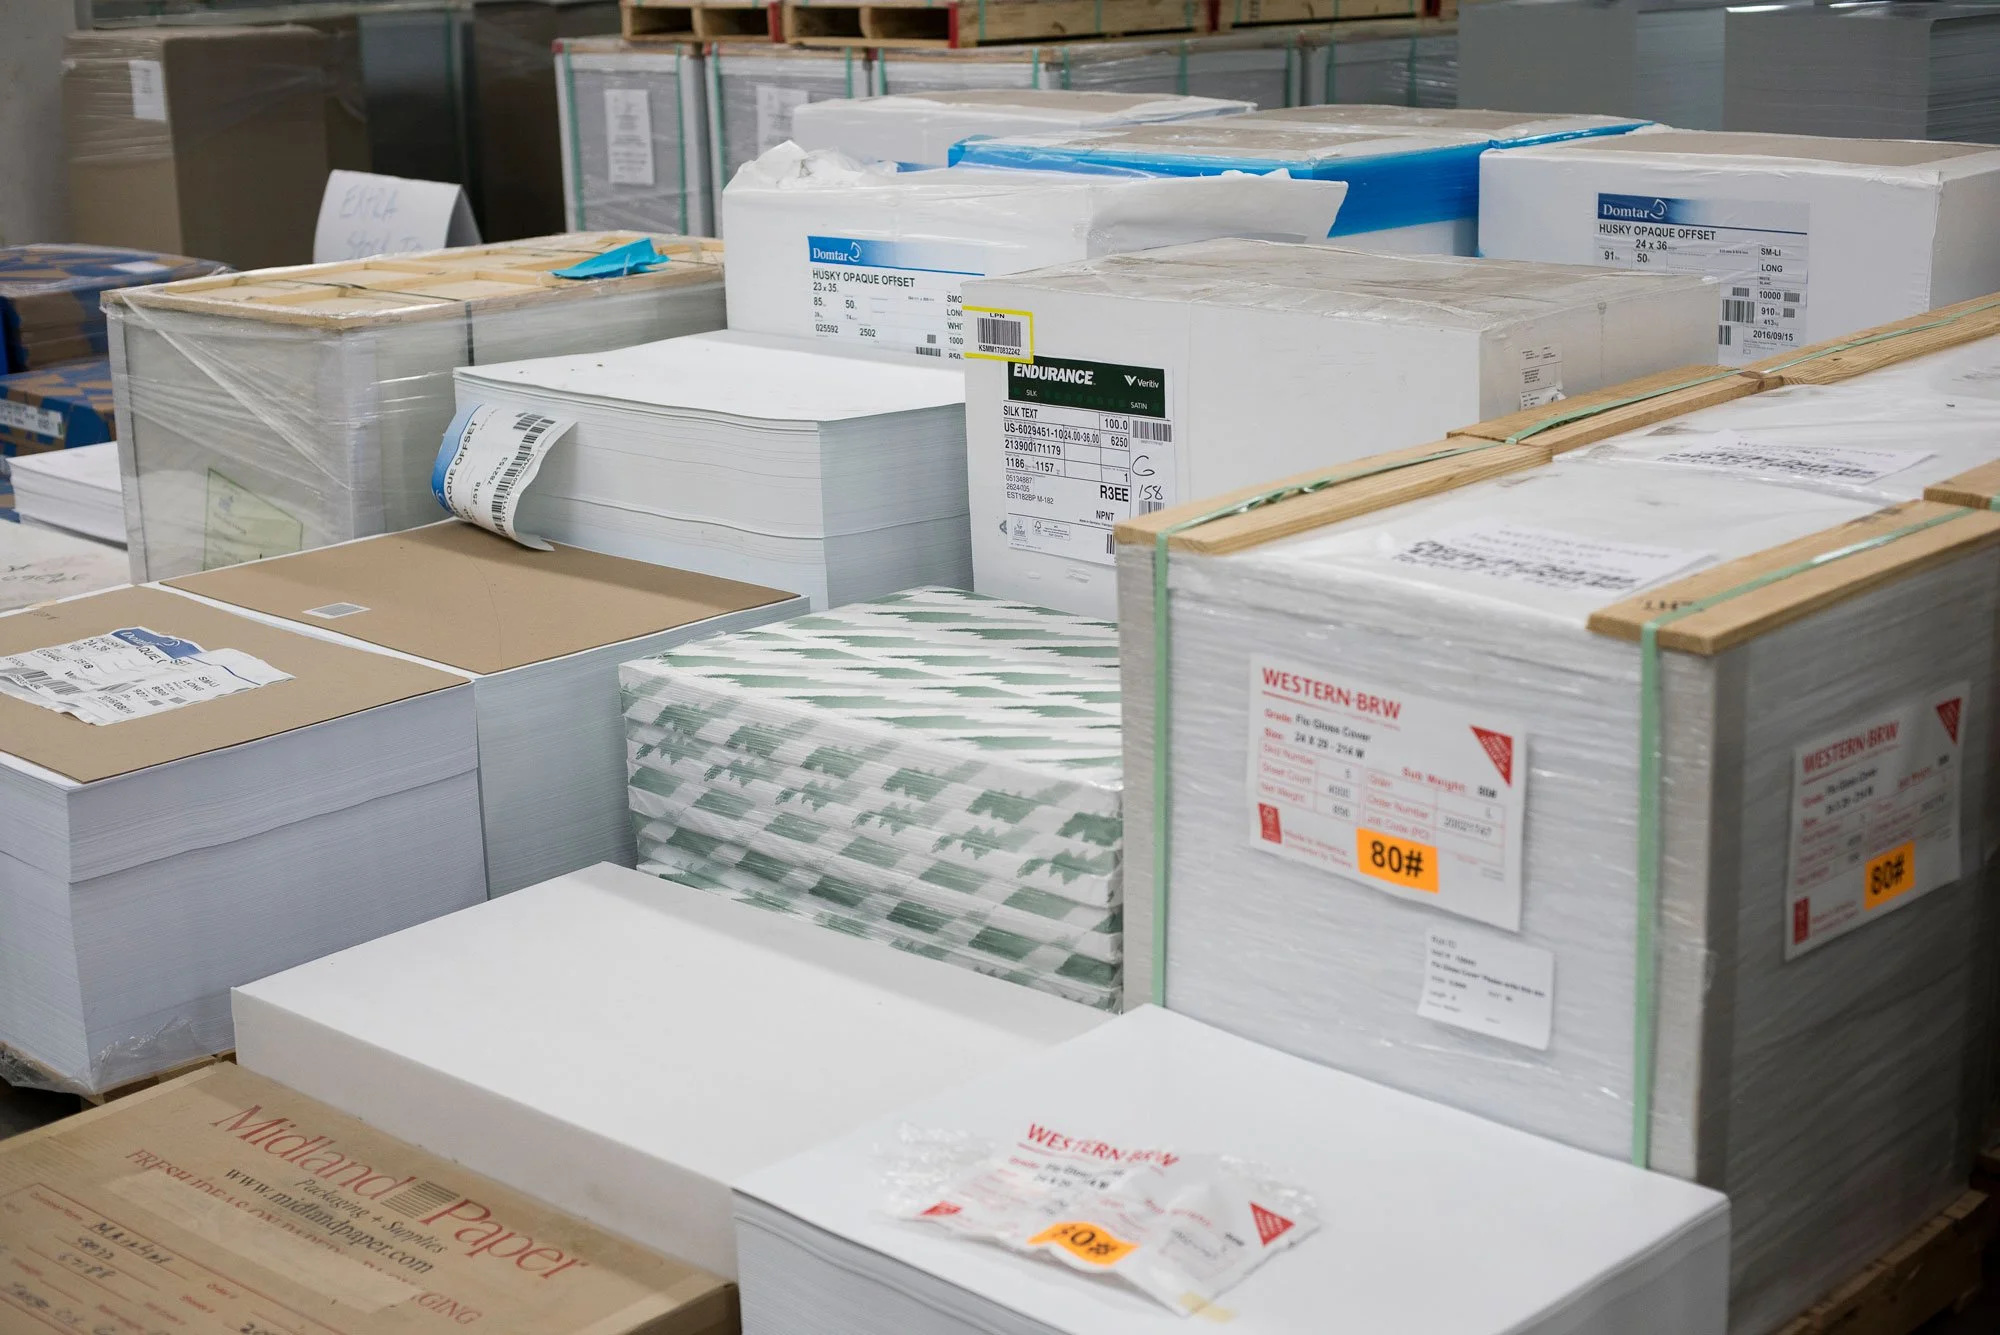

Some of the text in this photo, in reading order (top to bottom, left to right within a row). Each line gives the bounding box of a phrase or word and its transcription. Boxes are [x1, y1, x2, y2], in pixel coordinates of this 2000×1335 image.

[1603, 204, 1649, 218] Domtar
[1599, 224, 1716, 241] HUSKY OPAQUE OFFSET
[1635, 239, 1668, 251] 24 x 36
[813, 247, 849, 262] Domtar
[1604, 250, 1614, 260] 91
[1636, 253, 1648, 263] 50
[1761, 248, 1781, 256] SM-LI
[1761, 264, 1783, 273] LONG
[812, 269, 915, 288] HUSKY OPAQUE OFFSET
[813, 282, 823, 292] 23
[828, 283, 838, 293] 35
[813, 297, 823, 306] 85
[1759, 291, 1781, 300] 10000
[845, 299, 855, 309] 50
[1761, 307, 1775, 316] 910
[815, 324, 839, 334] 025592
[859, 327, 876, 338] 2502
[1753, 330, 1794, 341] 2016/09/15
[1013, 363, 1094, 386] ENDURANCE
[1137, 379, 1160, 389] Veritiv
[1026, 389, 1038, 397] SILK
[1003, 406, 1038, 419] SILK TEXT
[1130, 402, 1148, 410] SATIN
[1105, 418, 1128, 430] 100.0
[1004, 422, 1064, 440] US-6029451-10
[454, 420, 478, 465] OFFSET
[1004, 439, 1061, 456] 213900171179
[1110, 436, 1128, 448] 6250
[1006, 457, 1025, 469] 1186
[1035, 460, 1054, 473] 1157
[486, 456, 509, 485] 782153
[1124, 473, 1128, 483] 1
[472, 481, 482, 505] 2518
[1100, 484, 1129, 502] R3EE
[1096, 510, 1115, 522] NPNT
[183, 679, 205, 692] LONG
[1262, 666, 1402, 720] WESTERN-BRW
[1313, 719, 1340, 735] Gloss
[1342, 726, 1371, 742] Cover
[1802, 721, 1900, 773] WESTERN-BRW
[1277, 788, 1304, 803] Weight
[1394, 800, 1429, 819] Number
[1370, 840, 1424, 878] 80#
[1870, 853, 1905, 897] 80#
[209, 1104, 417, 1202] Midland
[419, 1198, 590, 1280] Paper
[224, 1167, 433, 1274] www.midlandpaper.com
[294, 1178, 371, 1219] Packaging
[382, 1215, 449, 1254] Supplies
